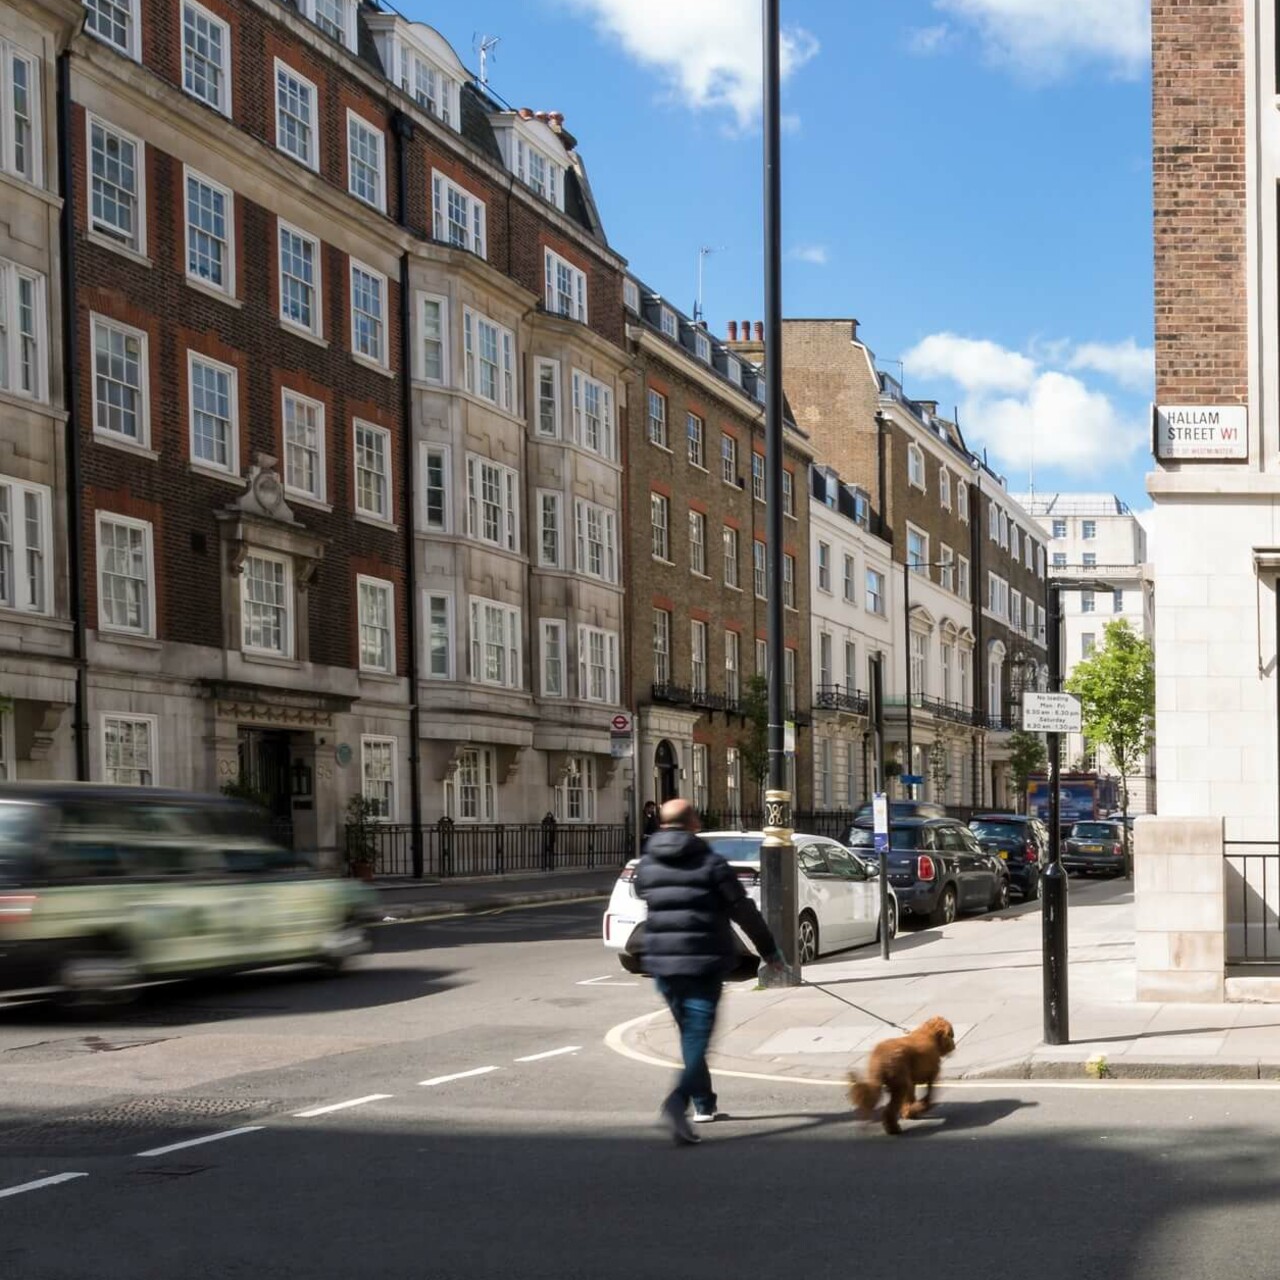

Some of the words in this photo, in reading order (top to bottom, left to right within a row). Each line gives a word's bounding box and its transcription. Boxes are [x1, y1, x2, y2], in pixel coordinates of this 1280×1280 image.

[1168, 412, 1219, 424] HALLAM
[1168, 427, 1216, 440] STREET
[1221, 427, 1237, 440] W1
